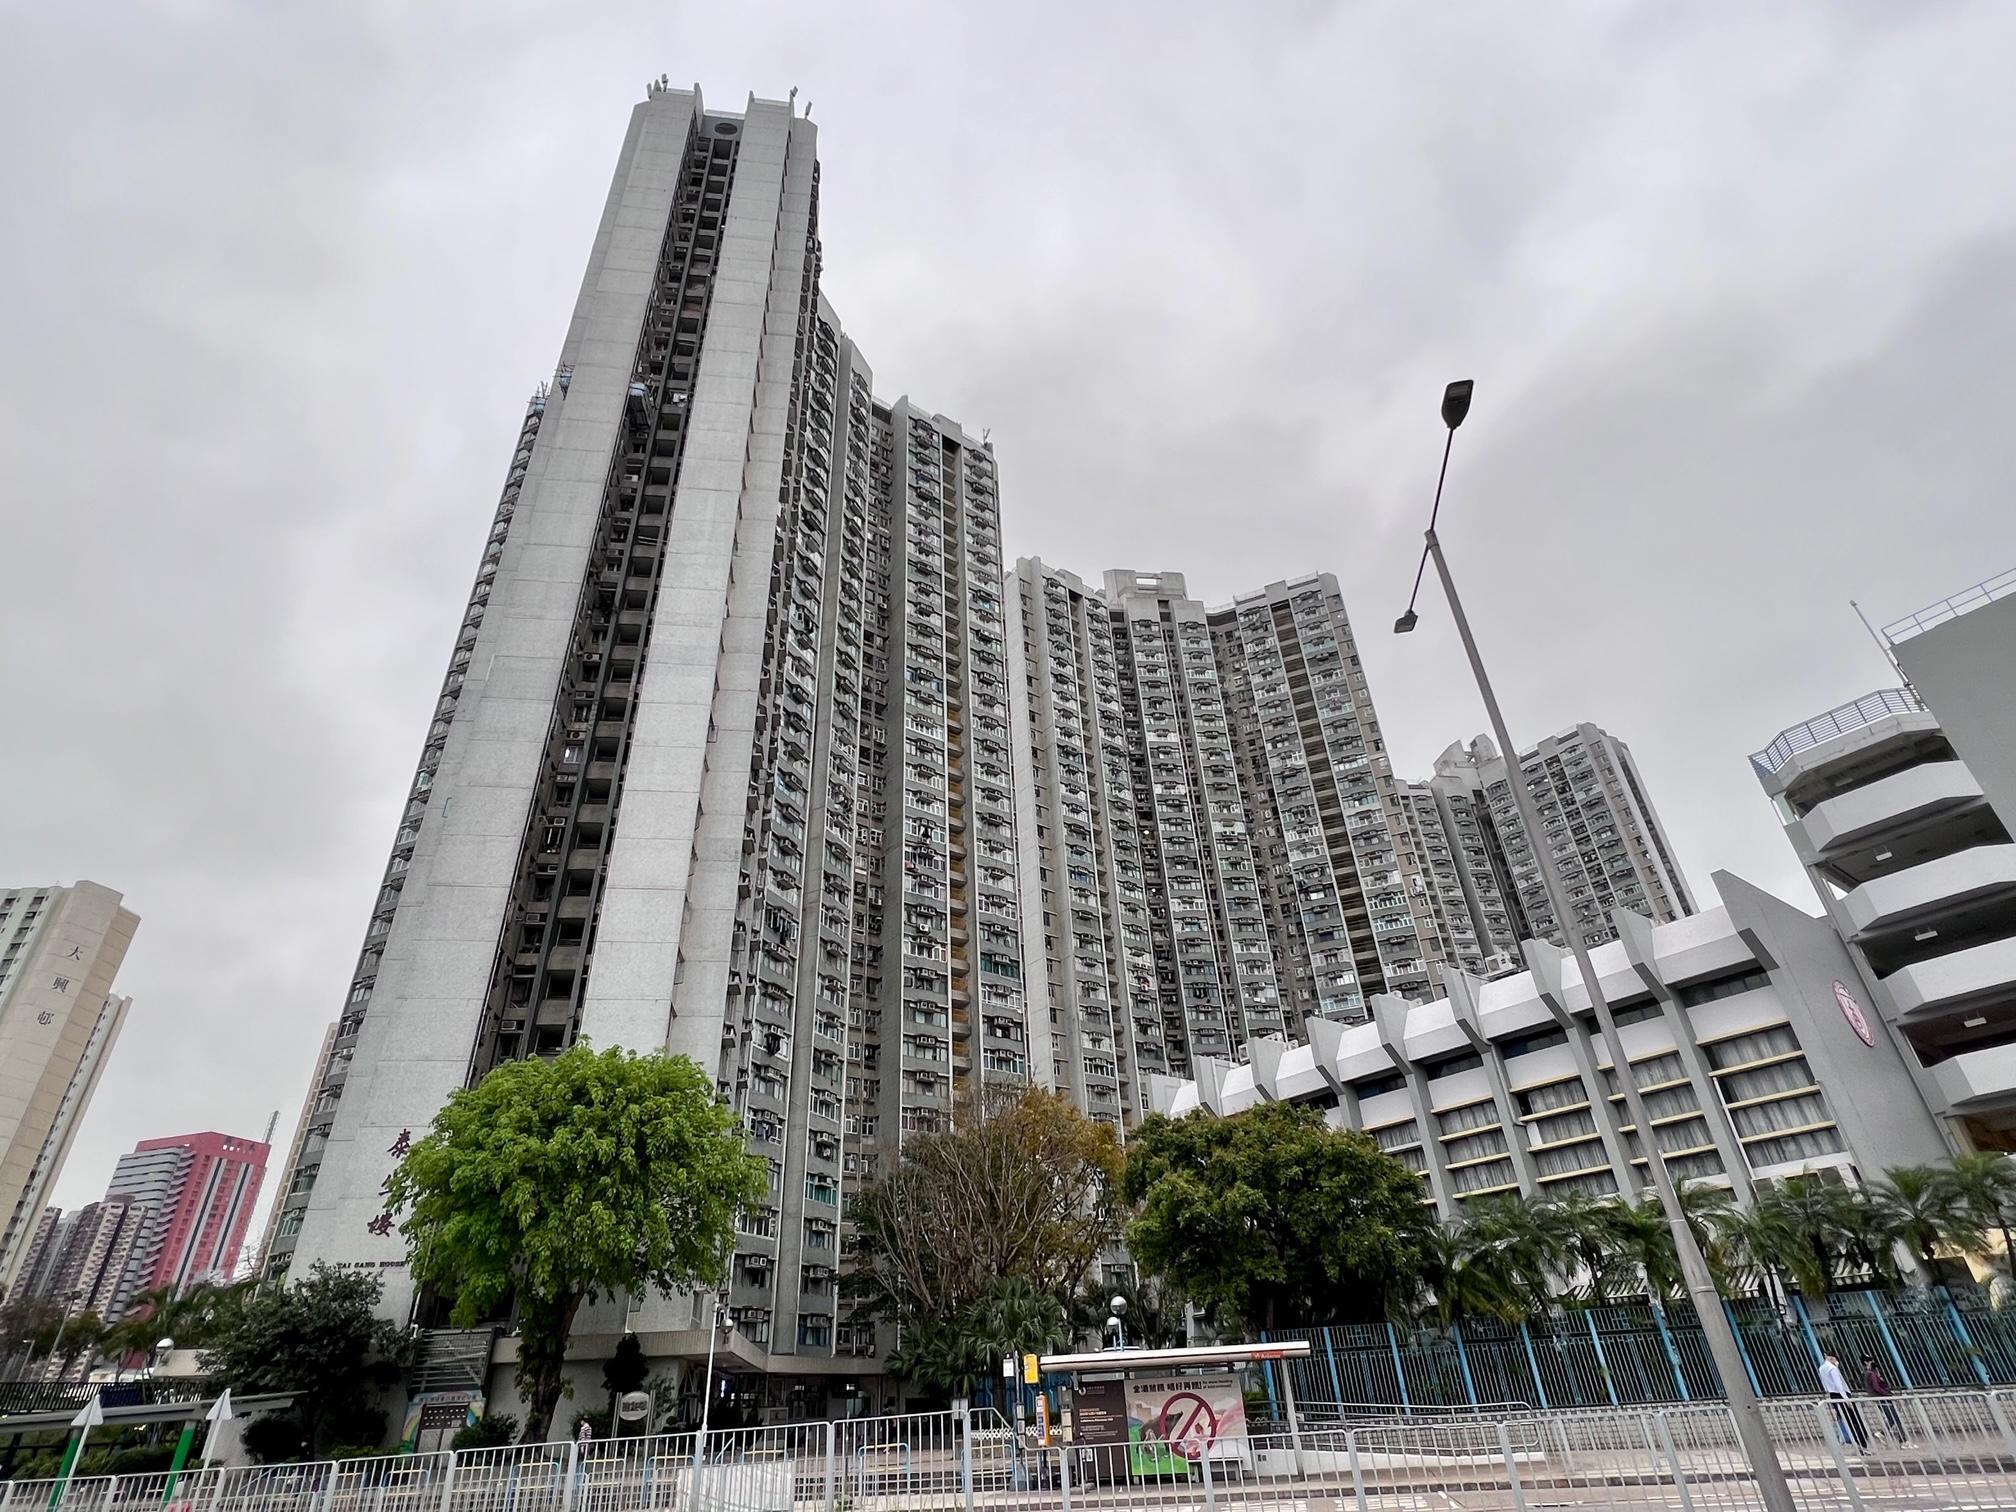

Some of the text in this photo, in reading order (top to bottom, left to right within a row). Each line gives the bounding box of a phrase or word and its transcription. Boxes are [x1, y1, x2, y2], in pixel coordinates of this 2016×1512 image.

[37, 946, 83, 1025] 大興邨
[367, 1129, 410, 1237] 泰樓
